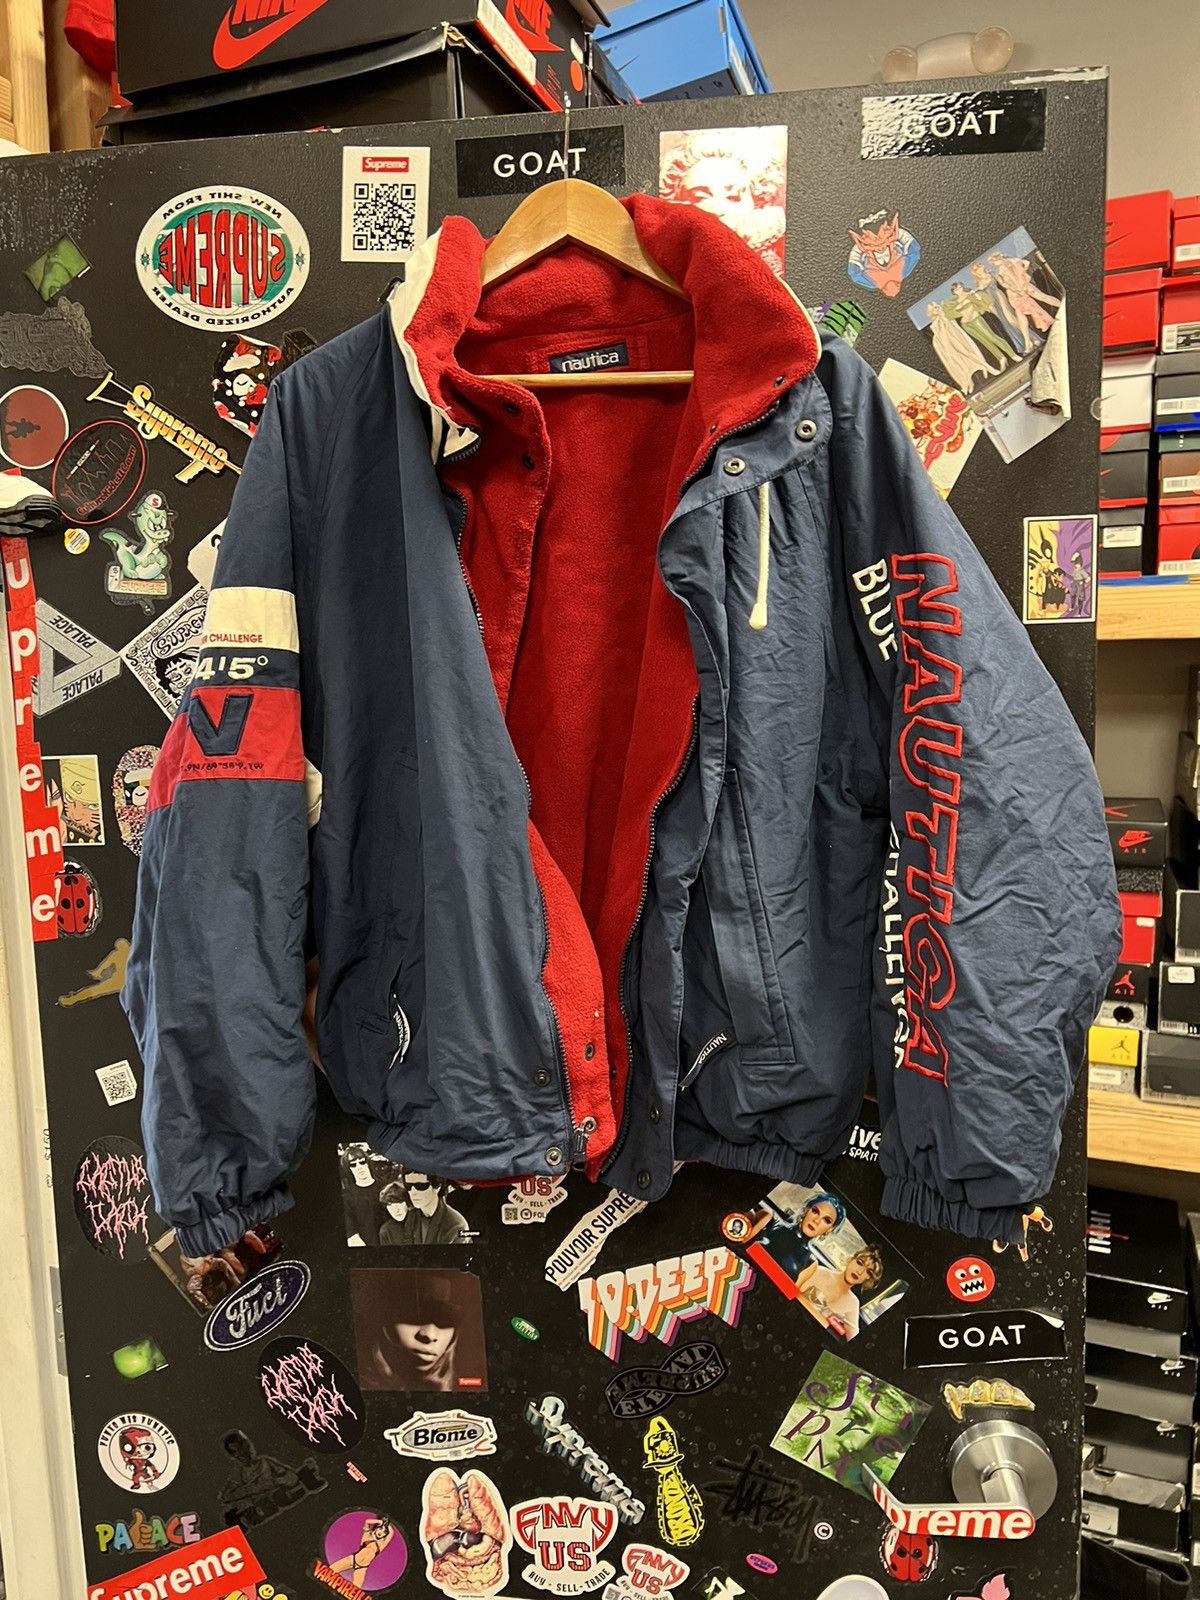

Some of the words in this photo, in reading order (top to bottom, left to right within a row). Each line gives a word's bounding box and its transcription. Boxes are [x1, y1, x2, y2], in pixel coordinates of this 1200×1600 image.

[902, 109, 1004, 139] GOAT
[493, 147, 587, 178] GOAT
[561, 350, 620, 372] nautica
[125, 384, 229, 474] Supreme
[852, 558, 898, 662] BLUE
[49, 614, 98, 650] PALACE
[209, 633, 263, 643] CHALLENGE
[62, 668, 104, 702] PALACE
[890, 552, 963, 1089] NAUTICA
[545, 1229, 599, 1282] POUVOIR
[591, 1191, 637, 1234] SUPRE
[938, 1324, 1026, 1349] GOAT
[413, 1424, 478, 1447] Bronze
[538, 1540, 592, 1572] US
[556, 1583, 579, 1593] SELL
[585, 1568, 611, 1589] TRADE
[631, 1568, 663, 1595] US
